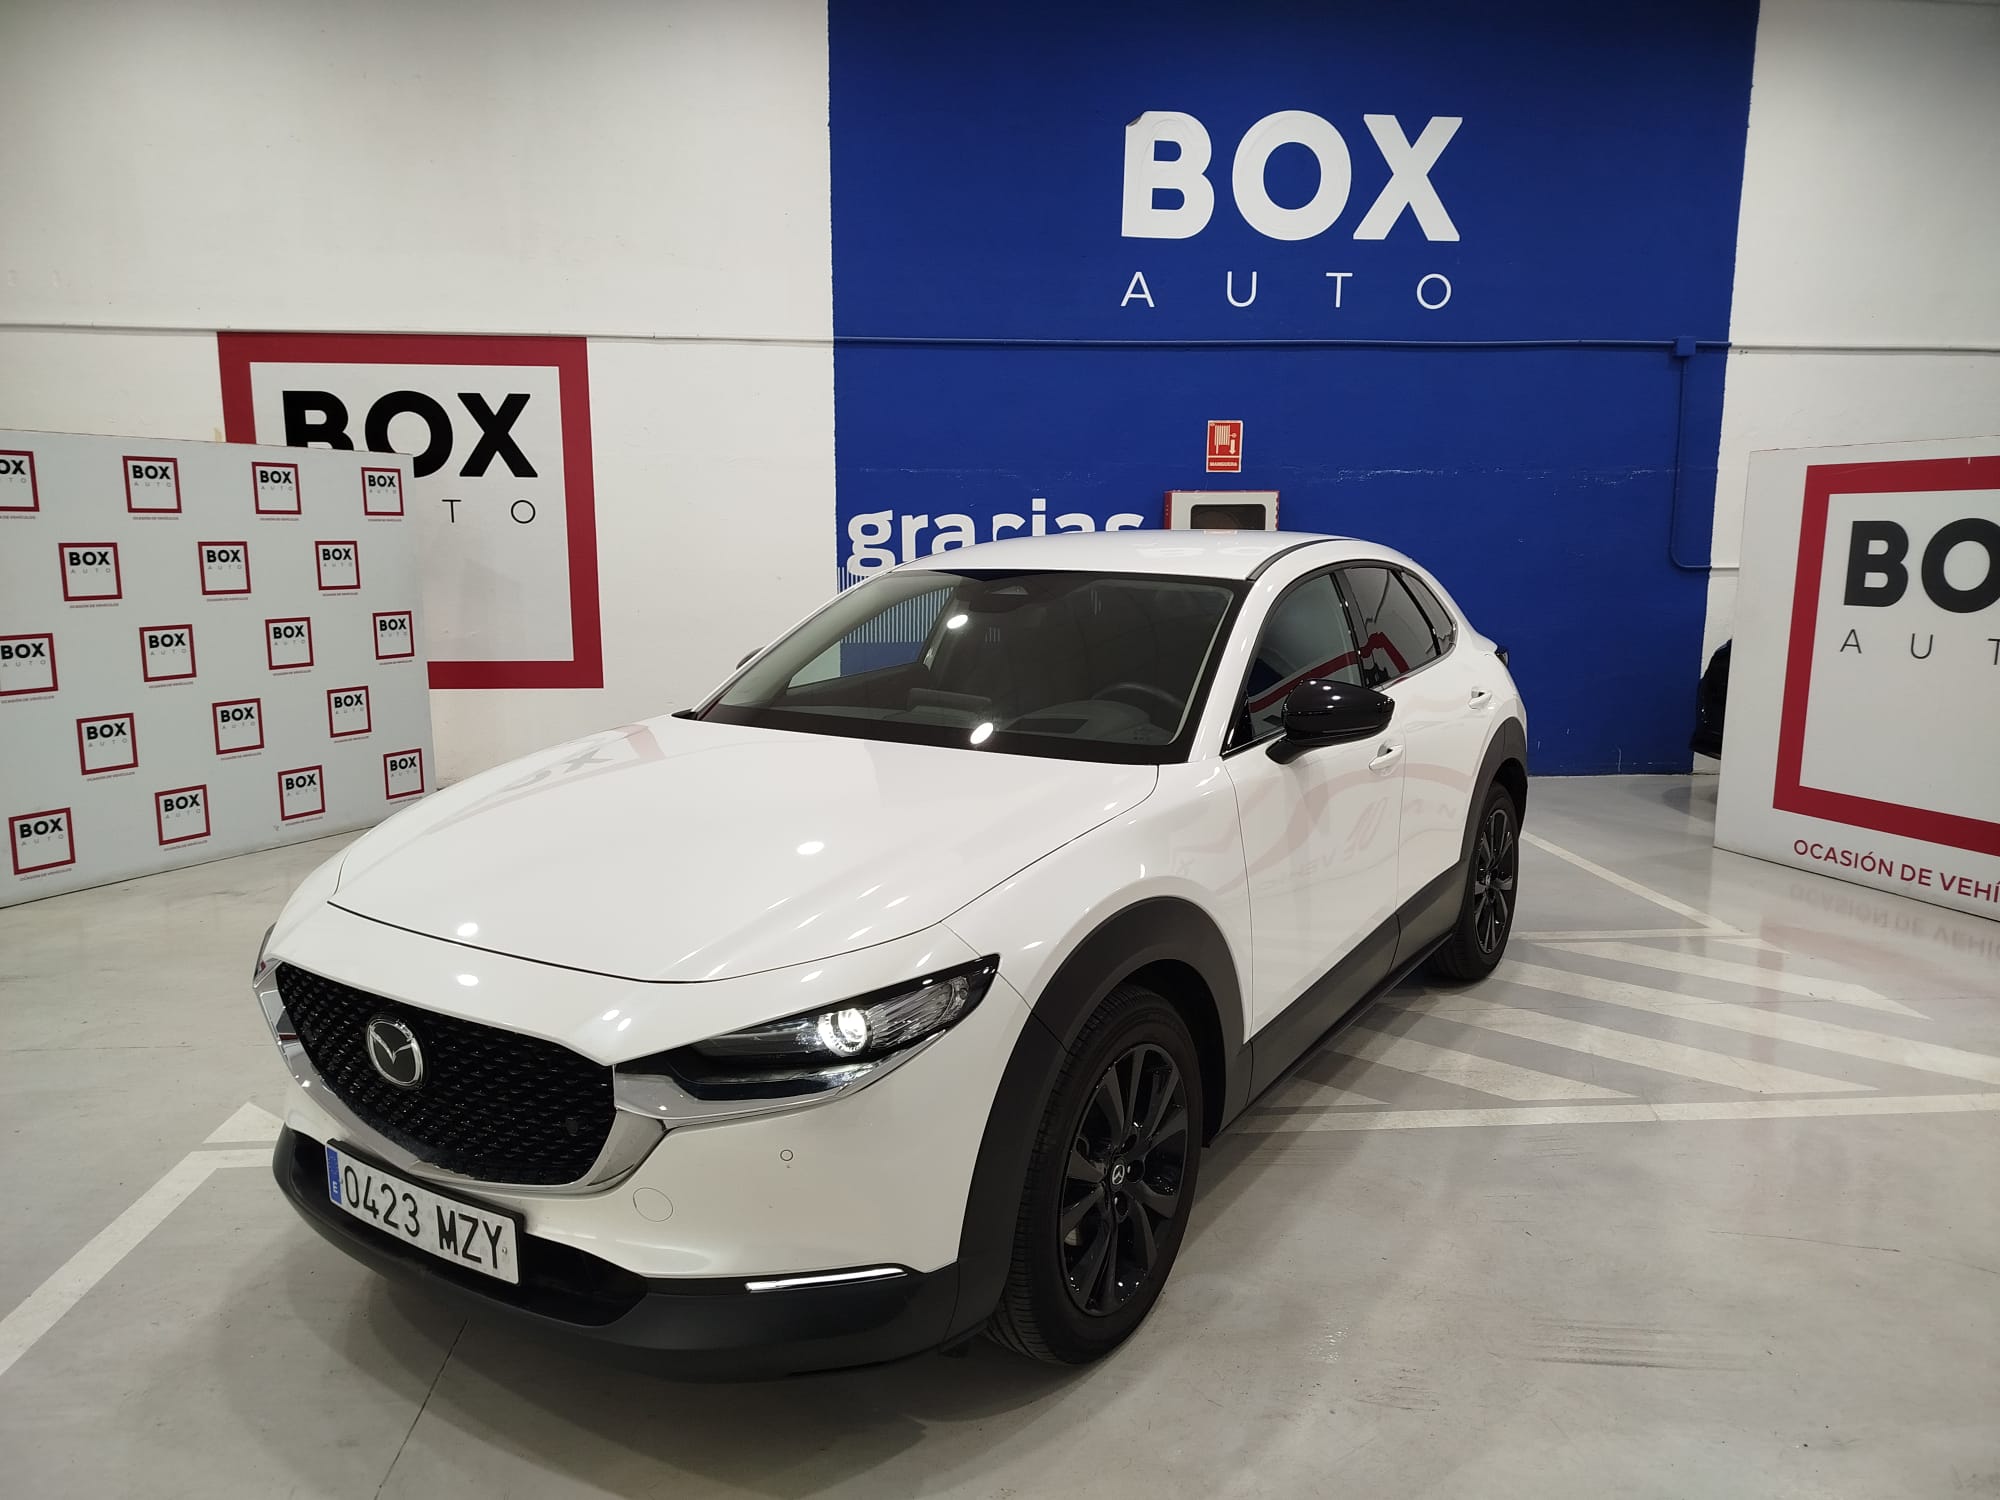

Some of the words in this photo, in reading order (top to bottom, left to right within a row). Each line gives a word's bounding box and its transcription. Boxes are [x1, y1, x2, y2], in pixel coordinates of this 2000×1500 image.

[1122, 110, 1463, 241] BOX
[1120, 271, 1452, 309] AUTO
[282, 390, 538, 477] BOX
[0, 459, 26, 475] OX
[132, 465, 171, 480] BOX
[260, 470, 292, 484] BOX
[368, 475, 396, 488] BOX
[68, 551, 110, 567] BOX
[206, 549, 241, 563] BOX
[322, 548, 352, 561] BOX
[1840, 518, 2000, 613] BO
[273, 625, 305, 639] BOX
[379, 618, 407, 631] BOX
[149, 633, 186, 649] BOX
[1, 642, 45, 659] BOX
[151, 648, 187, 656] AUTO
[2, 659, 46, 668] AUTO
[334, 693, 364, 708] BOX
[220, 706, 255, 723] BOX
[335, 706, 364, 714] AUTO
[86, 722, 127, 740] BOX
[222, 721, 256, 730] AUTO
[88, 738, 128, 748] AUTO
[390, 756, 417, 772] BOX
[285, 773, 317, 790] BOX
[286, 787, 317, 797] AUTO
[164, 794, 200, 812] BOX
[165, 808, 201, 819] AUTO
[19, 817, 63, 839] BOX
[21, 834, 64, 846] AUTO
[1793, 839, 1893, 877] OCASIÓN
[1900, 863, 1933, 887] DE
[1940, 872, 2000, 903] VEHÍ
[332, 1181, 339, 1194] E
[343, 1165, 421, 1238] 0423
[436, 1205, 503, 1269] MZY
